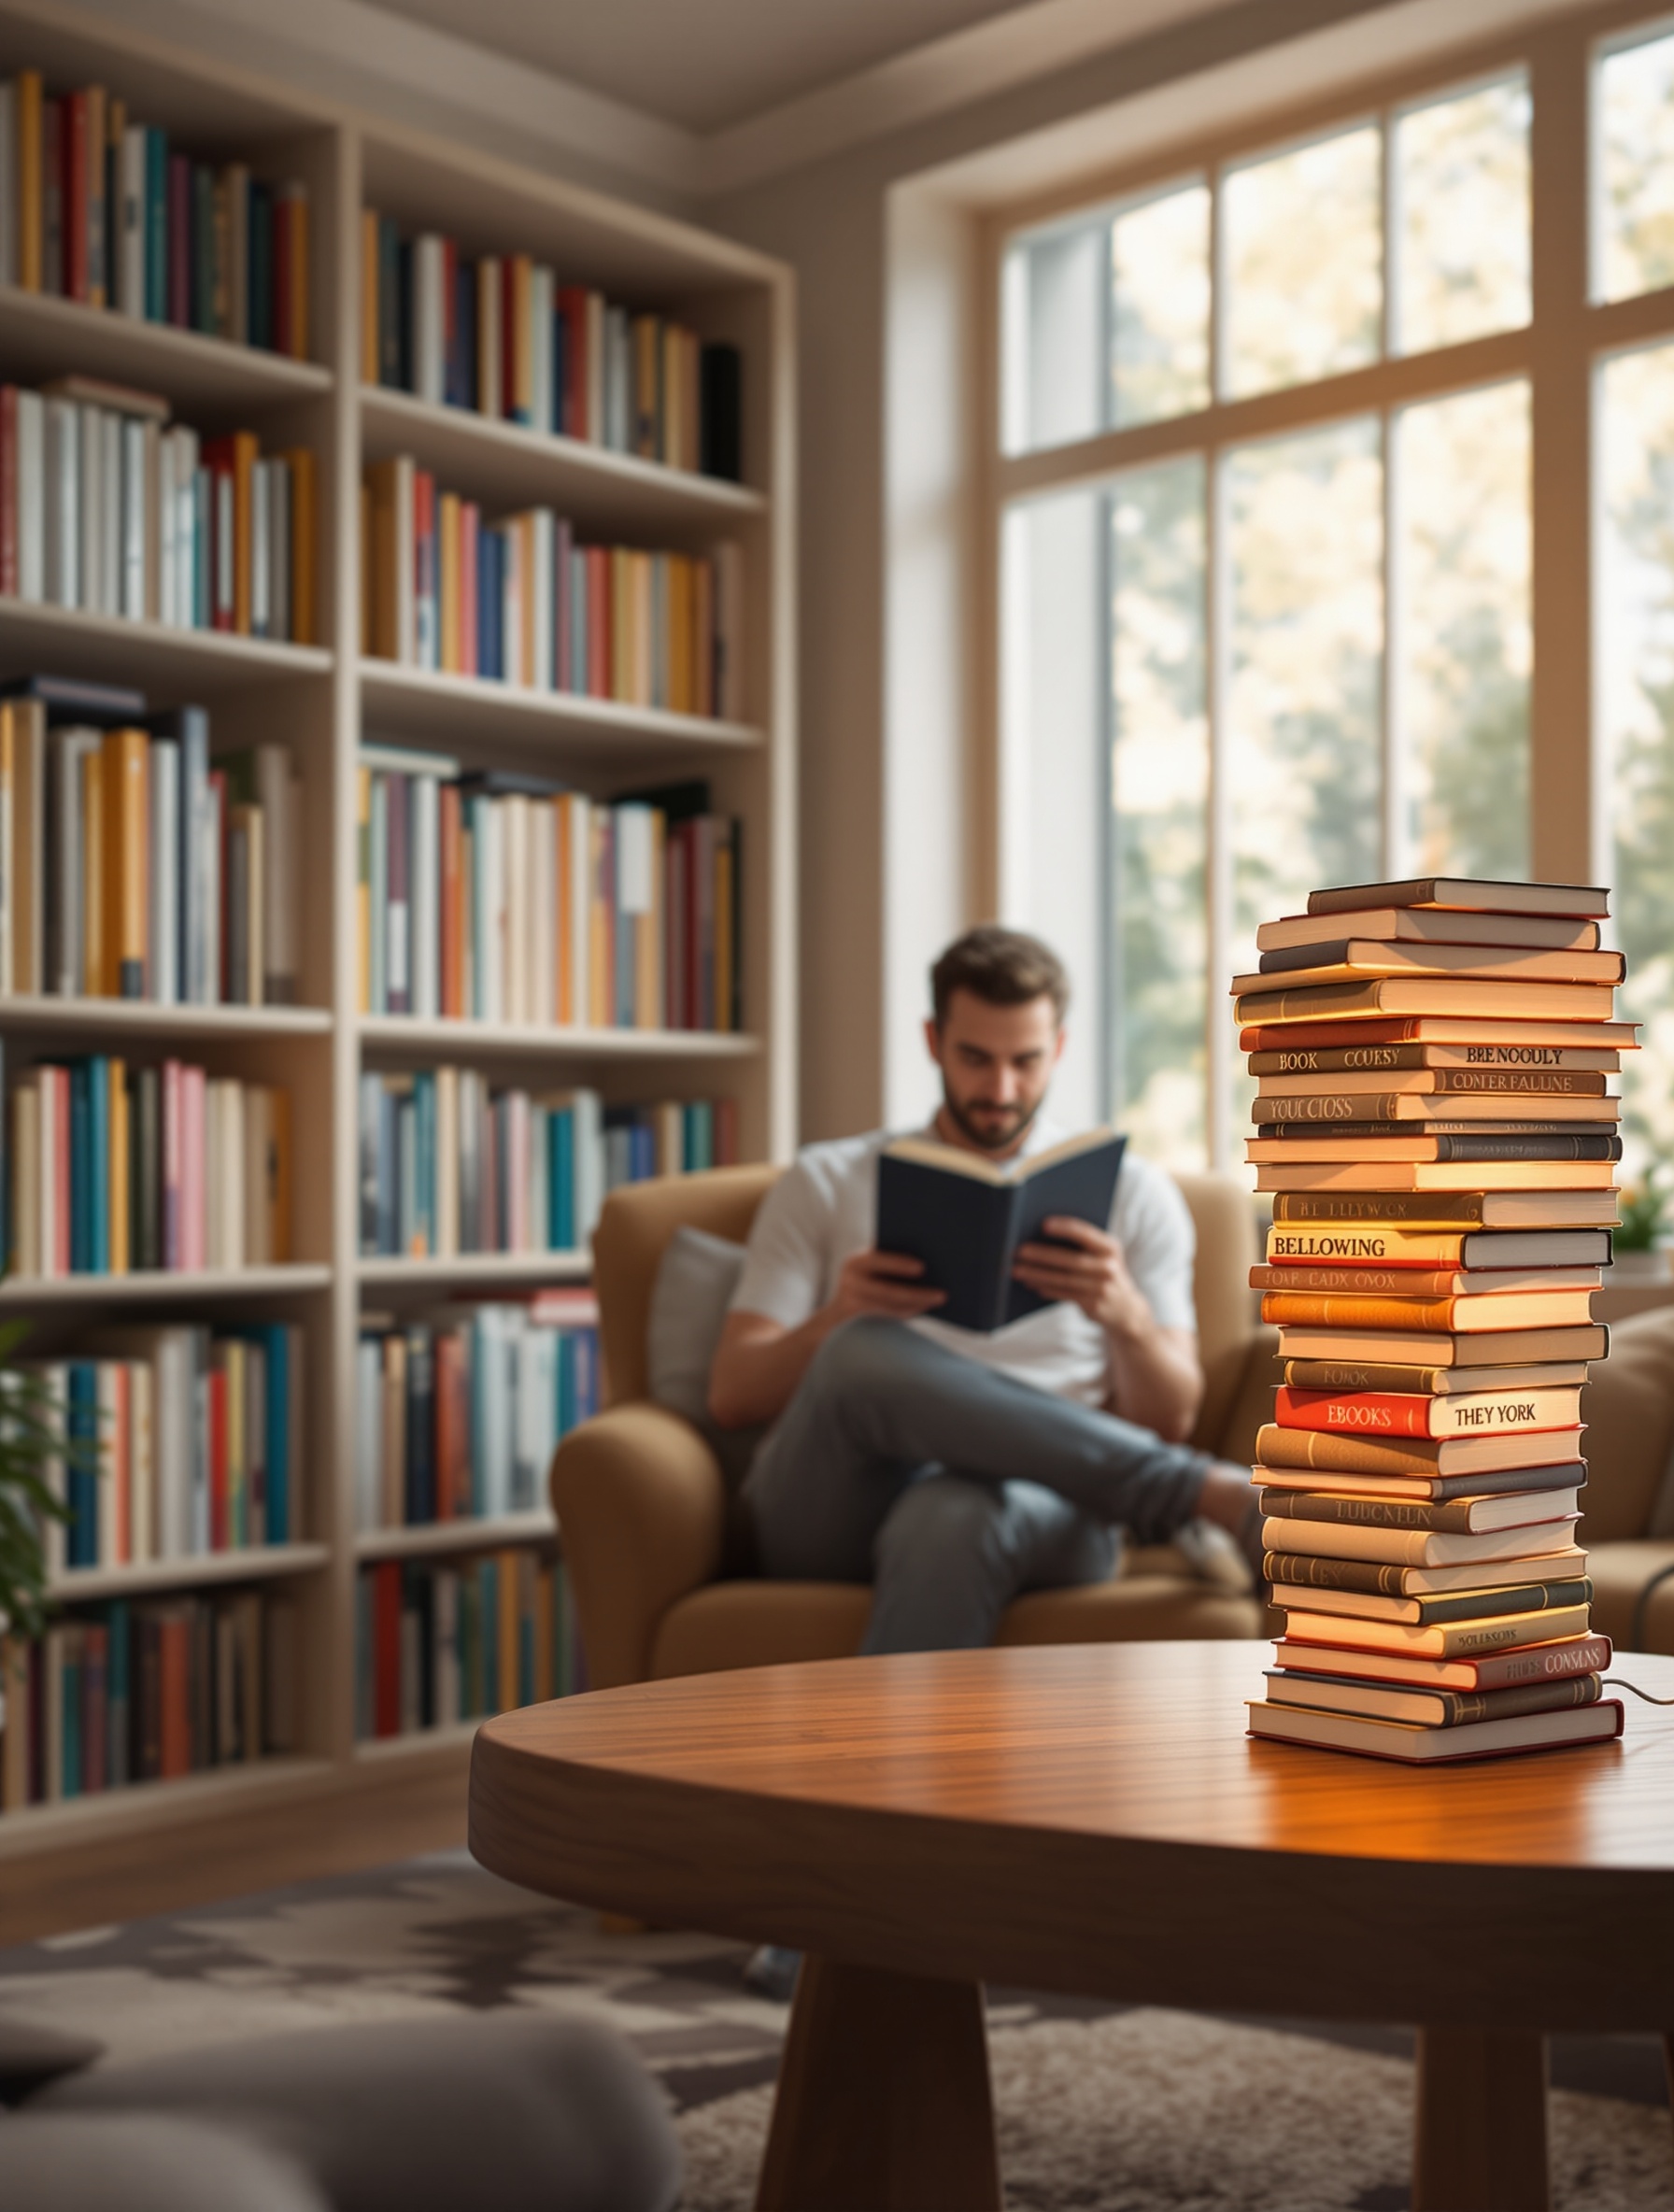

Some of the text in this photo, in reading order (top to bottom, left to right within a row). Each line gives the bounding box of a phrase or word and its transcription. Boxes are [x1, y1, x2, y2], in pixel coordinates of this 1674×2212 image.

[1279, 1052, 1318, 1071] BOOK
[1274, 1238, 1385, 1256] BELLOWING
[1327, 1404, 1392, 1428] EBOOKS
[1454, 1403, 1537, 1426] THEY YORK
